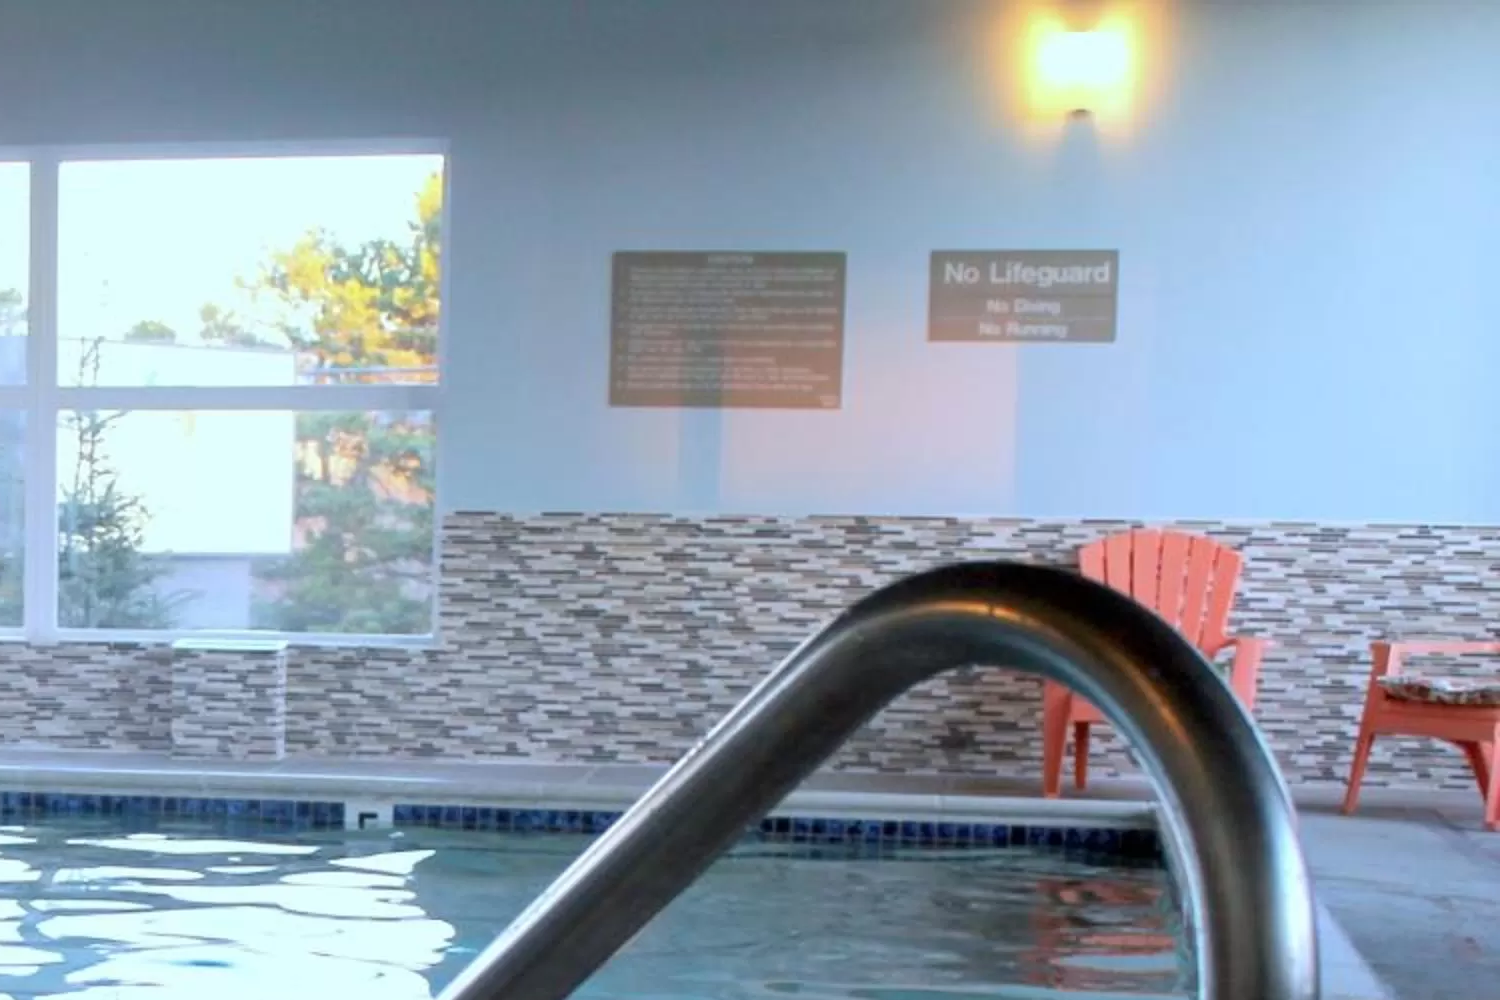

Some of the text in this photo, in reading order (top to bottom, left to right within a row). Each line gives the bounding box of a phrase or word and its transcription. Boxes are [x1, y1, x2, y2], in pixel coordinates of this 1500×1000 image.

[943, 261, 1111, 288] No Lifeguard
[986, 299, 1009, 313] No
[979, 321, 1069, 338] No Running
